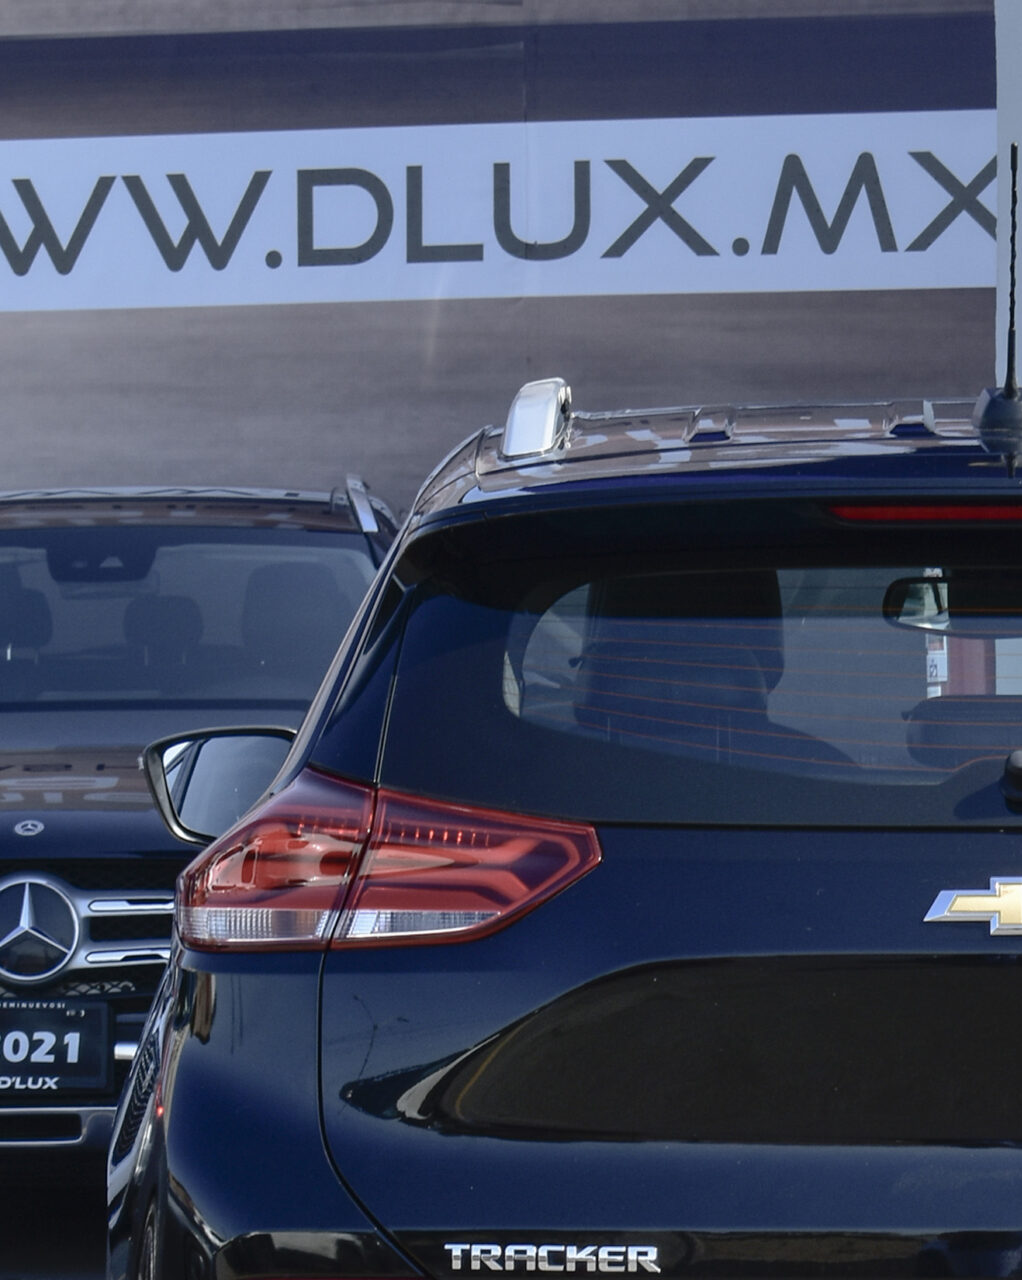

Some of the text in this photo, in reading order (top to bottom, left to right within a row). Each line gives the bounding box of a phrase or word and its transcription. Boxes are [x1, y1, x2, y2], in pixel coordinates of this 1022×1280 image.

[0, 1001, 62, 1009] EMINUEVOS
[0, 1030, 80, 1063] 021
[444, 1244, 661, 1273] TRACKER
